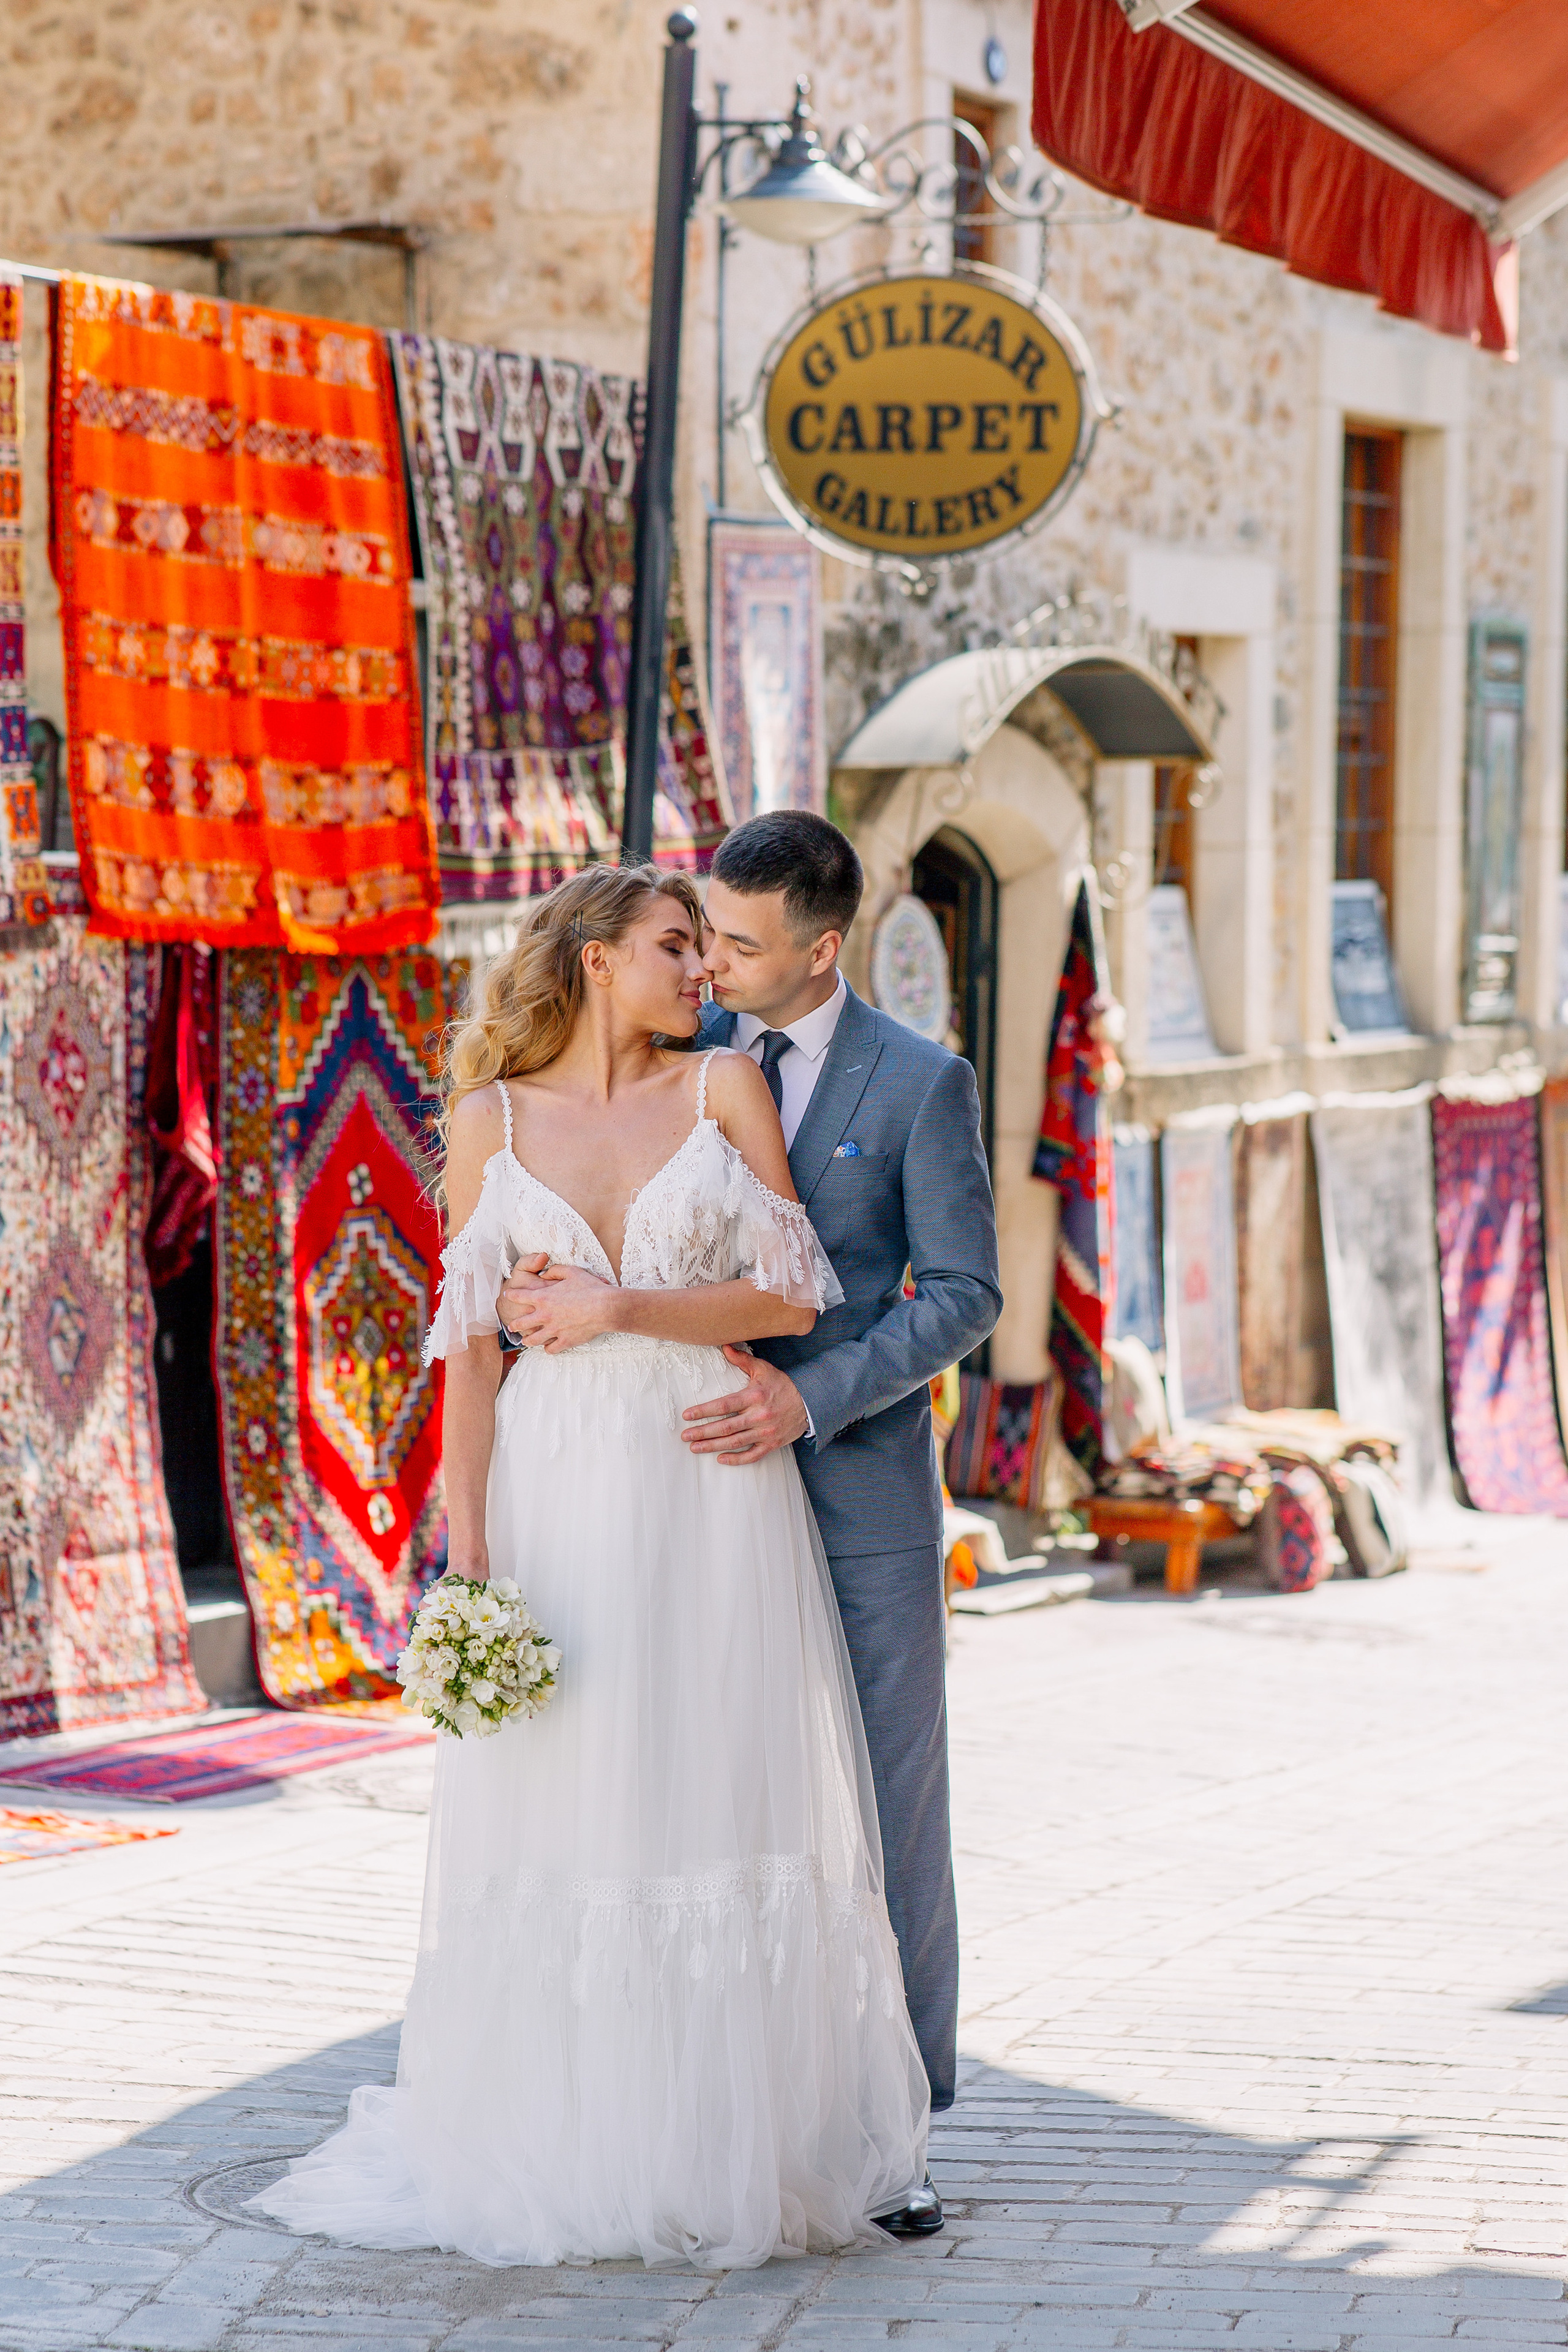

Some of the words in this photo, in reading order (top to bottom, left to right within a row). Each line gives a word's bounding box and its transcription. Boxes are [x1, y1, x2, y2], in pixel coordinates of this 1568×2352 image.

[799, 290, 1047, 392] GÜLİZAR
[787, 402, 1058, 454] CARPET
[815, 462, 1024, 538] GALLERY
